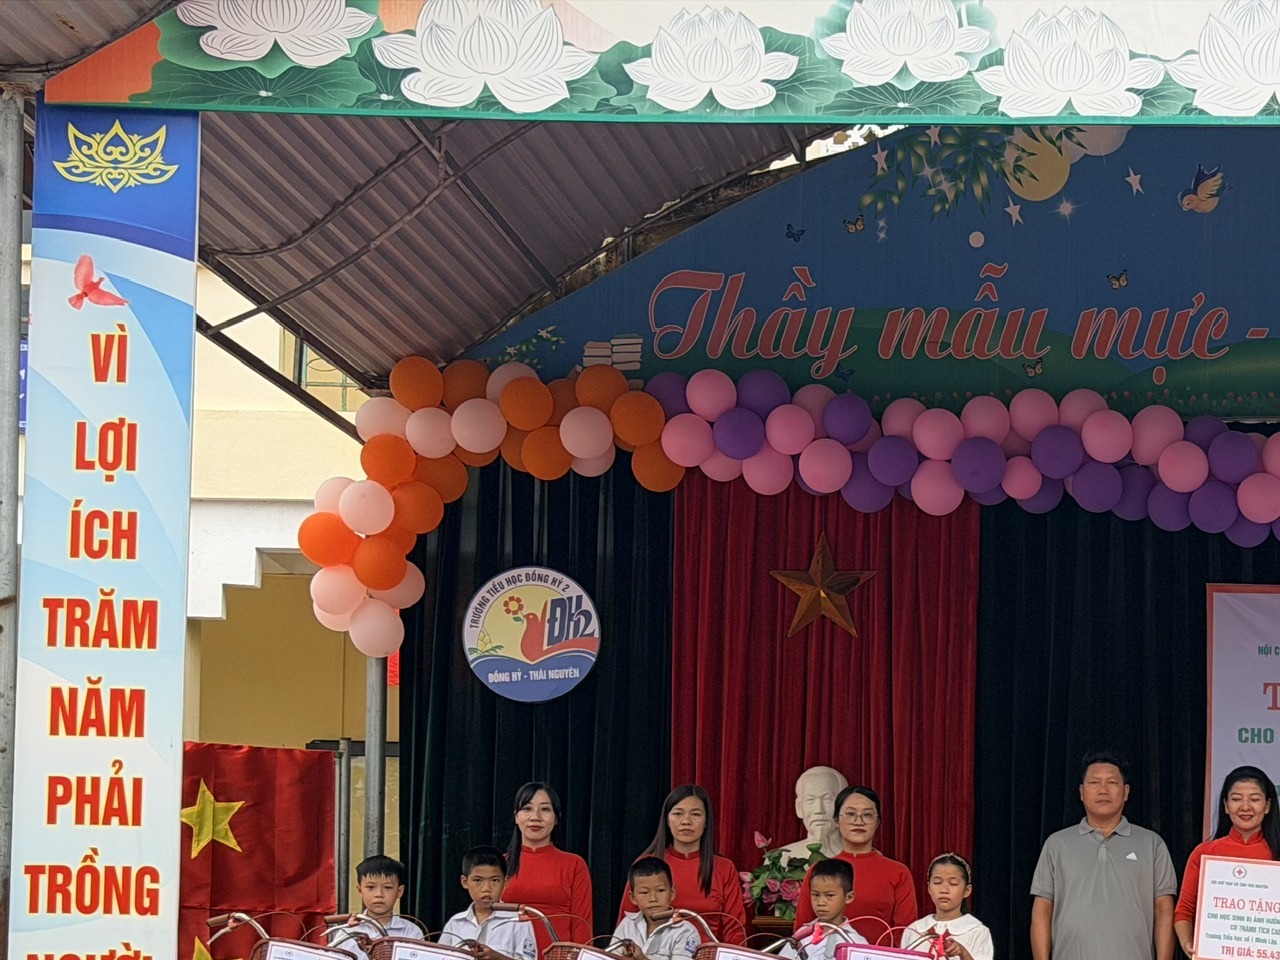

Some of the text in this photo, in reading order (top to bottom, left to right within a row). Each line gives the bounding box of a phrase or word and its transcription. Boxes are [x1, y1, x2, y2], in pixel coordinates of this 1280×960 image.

[91, 323, 129, 384] VÌ
[649, 266, 857, 379] Thầy
[878, 262, 1051, 360] mẫu
[1071, 292, 1232, 385] mực
[75, 417, 138, 482] LỢI
[69, 499, 138, 560] ÍCH
[42, 587, 159, 650] TRĂM
[470, 595, 490, 629] TRƯỜNG
[486, 580, 505, 597] TIỂU
[506, 573, 523, 587] HỌC
[562, 584, 570, 592] 2
[529, 669, 546, 680] THÁI
[549, 666, 579, 679] NGUYÊN
[1258, 645, 1272, 656] HỘI
[49, 676, 146, 738] NĂM
[1238, 727, 1274, 743] CHO
[46, 759, 143, 826] PHẢI
[24, 847, 161, 916] TRỒNG
[1213, 897, 1245, 910] TRAO
[1249, 898, 1280, 914] TẶNG
[1221, 946, 1234, 958] TRỊ
[1237, 945, 1254, 957] GIÁ:
